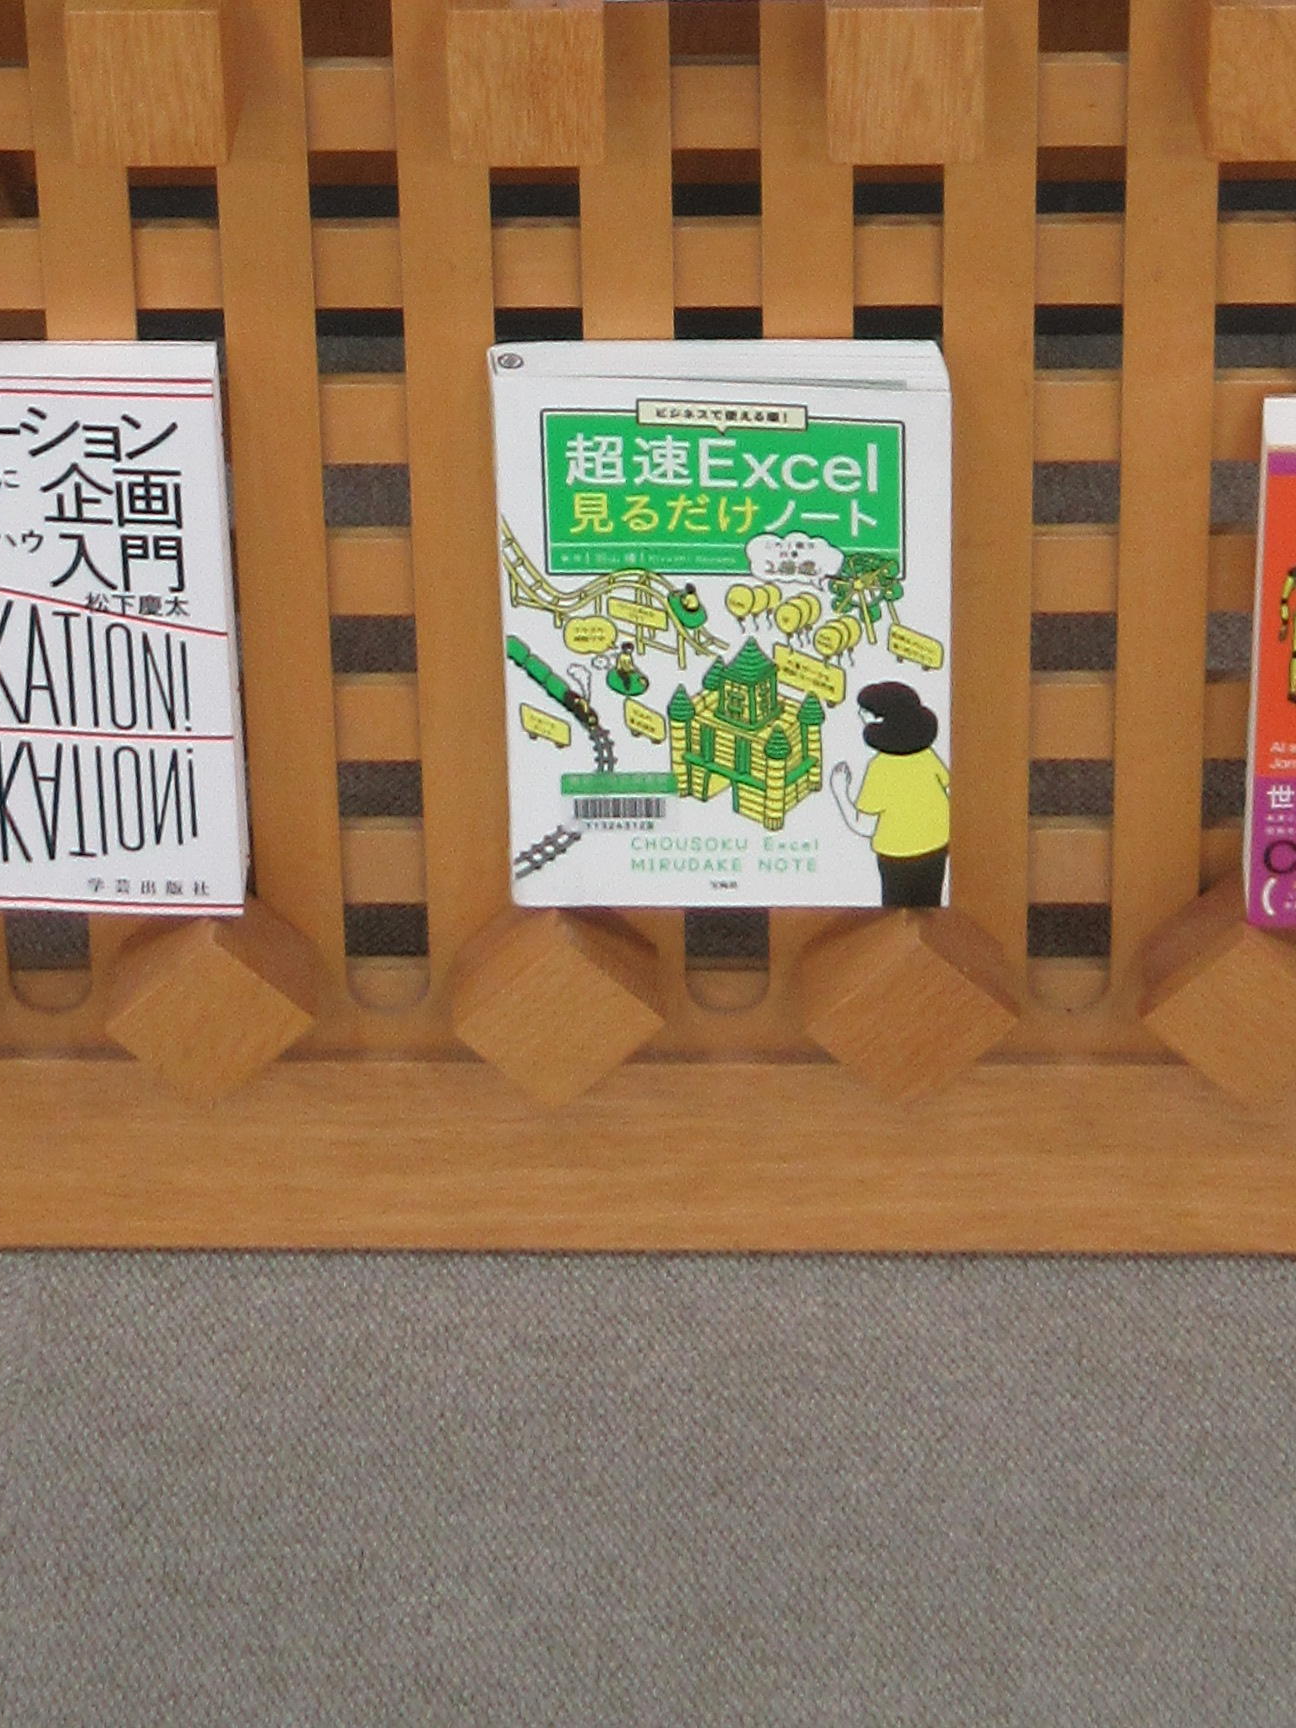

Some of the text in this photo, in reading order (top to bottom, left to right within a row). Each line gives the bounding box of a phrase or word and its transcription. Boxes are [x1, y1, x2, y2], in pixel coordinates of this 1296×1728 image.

[564, 432, 879, 495] 超速Excel
[40, 462, 184, 529] 企画
[569, 492, 878, 538] 見るだけノート
[49, 533, 186, 594] 入門
[631, 835, 749, 853] CHOUSOKU
[631, 857, 818, 874] MIRUDAKE NOTE
